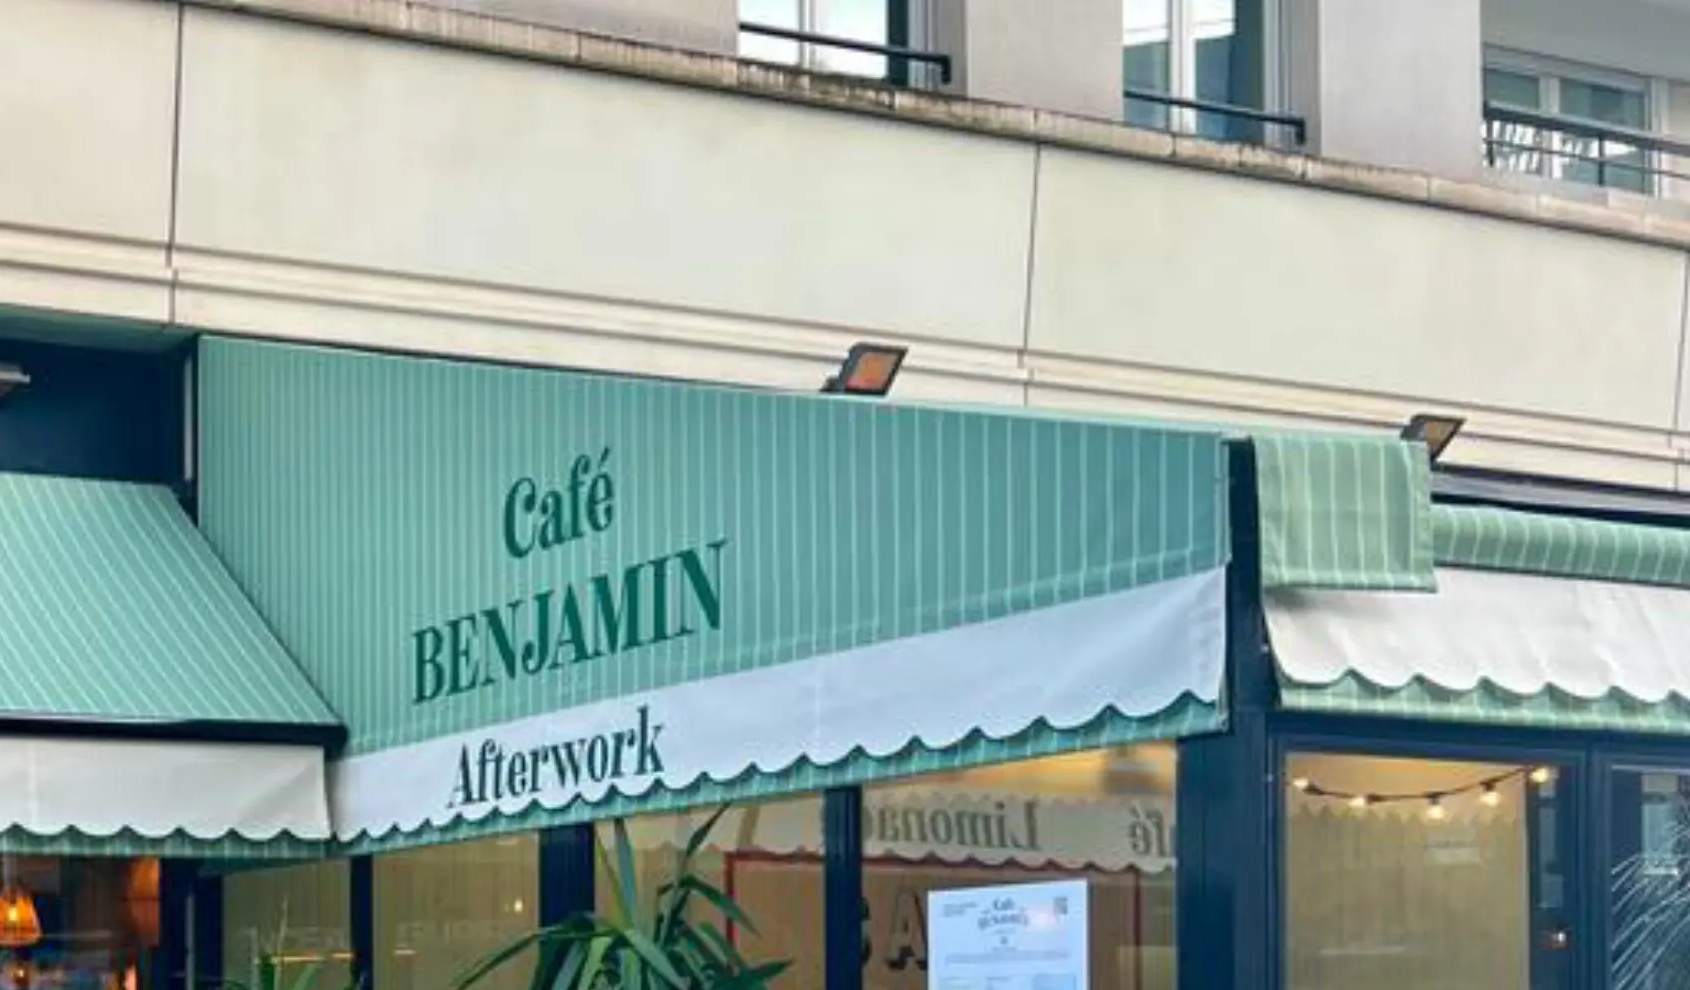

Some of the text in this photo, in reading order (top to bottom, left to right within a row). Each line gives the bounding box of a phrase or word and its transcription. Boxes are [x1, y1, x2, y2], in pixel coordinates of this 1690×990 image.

[504, 447, 615, 559] Café
[412, 538, 728, 705] BENJAMIN
[448, 703, 665, 809] Afterwork
